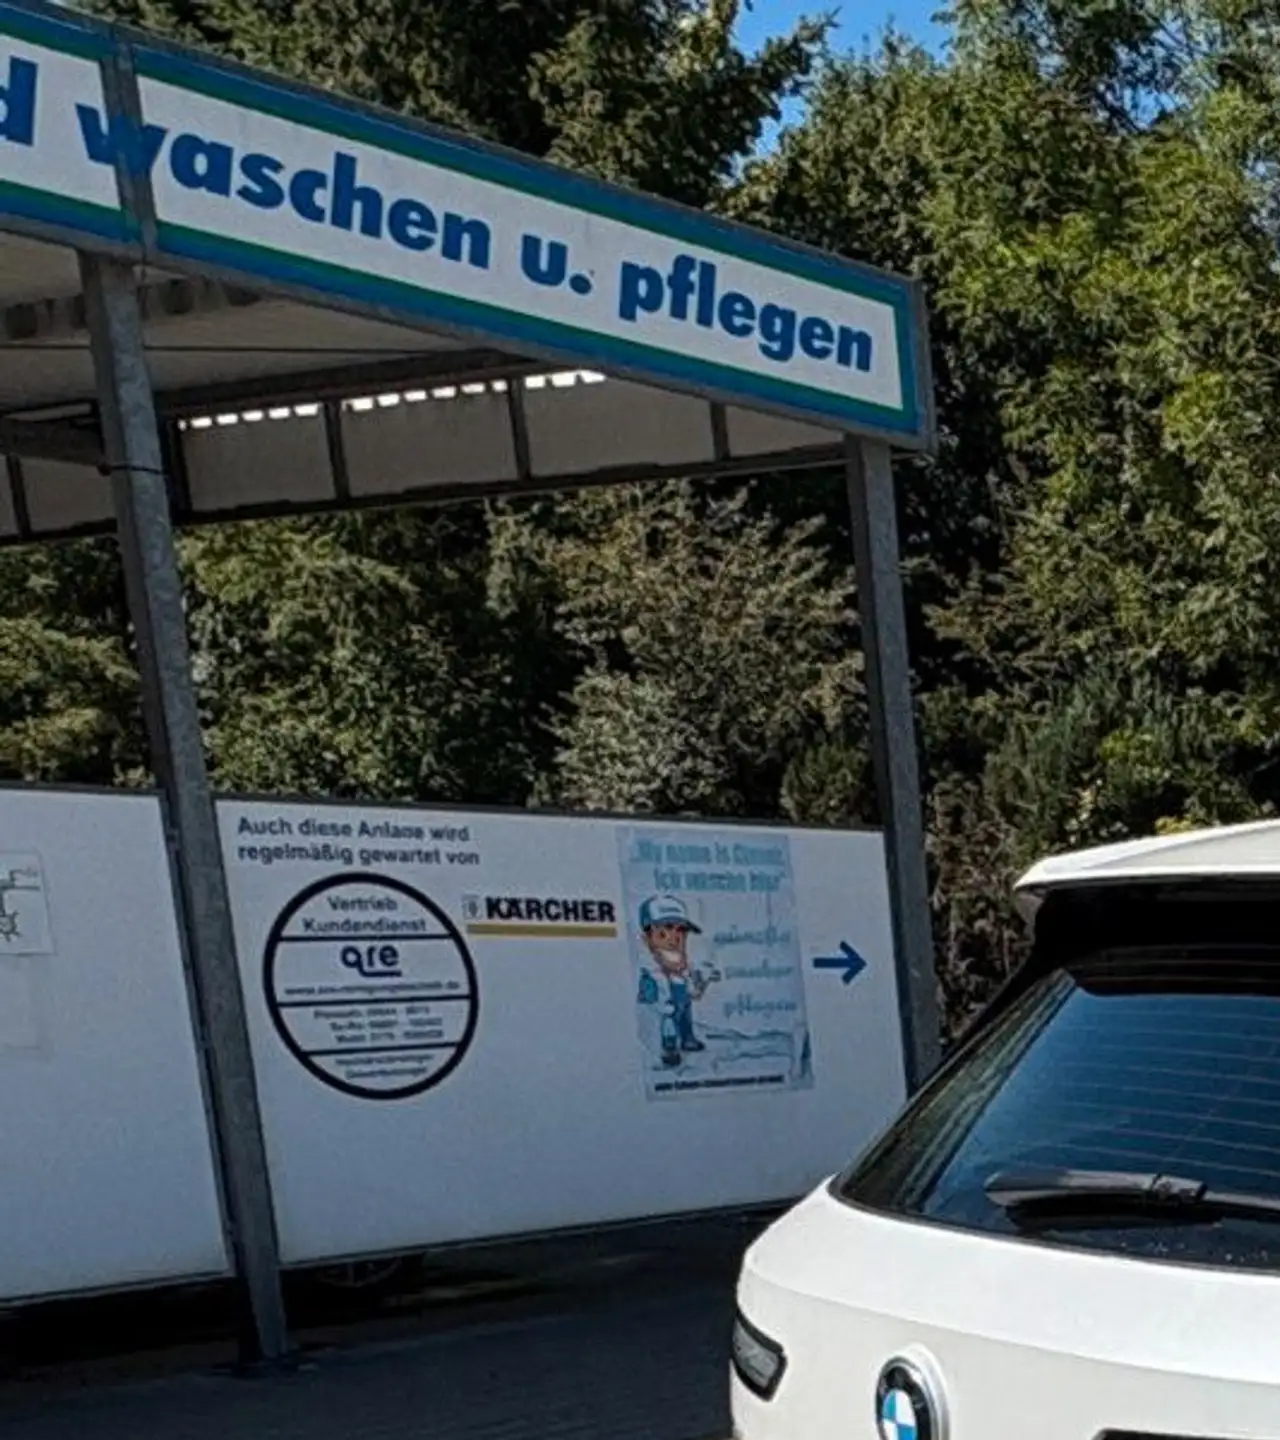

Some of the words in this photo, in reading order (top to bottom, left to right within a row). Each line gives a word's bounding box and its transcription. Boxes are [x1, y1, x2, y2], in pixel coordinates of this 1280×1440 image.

[76, 102, 491, 270] waschen
[521, 234, 593, 295] u.
[619, 253, 873, 372] pflegen
[238, 817, 292, 836] Auch
[298, 818, 352, 837] diese
[430, 825, 470, 842] wird
[237, 844, 353, 865] regelmäßig
[359, 848, 441, 866] gewartet
[446, 851, 480, 865] von
[327, 896, 398, 912] Vertrieb
[302, 917, 427, 934] Kundendienst
